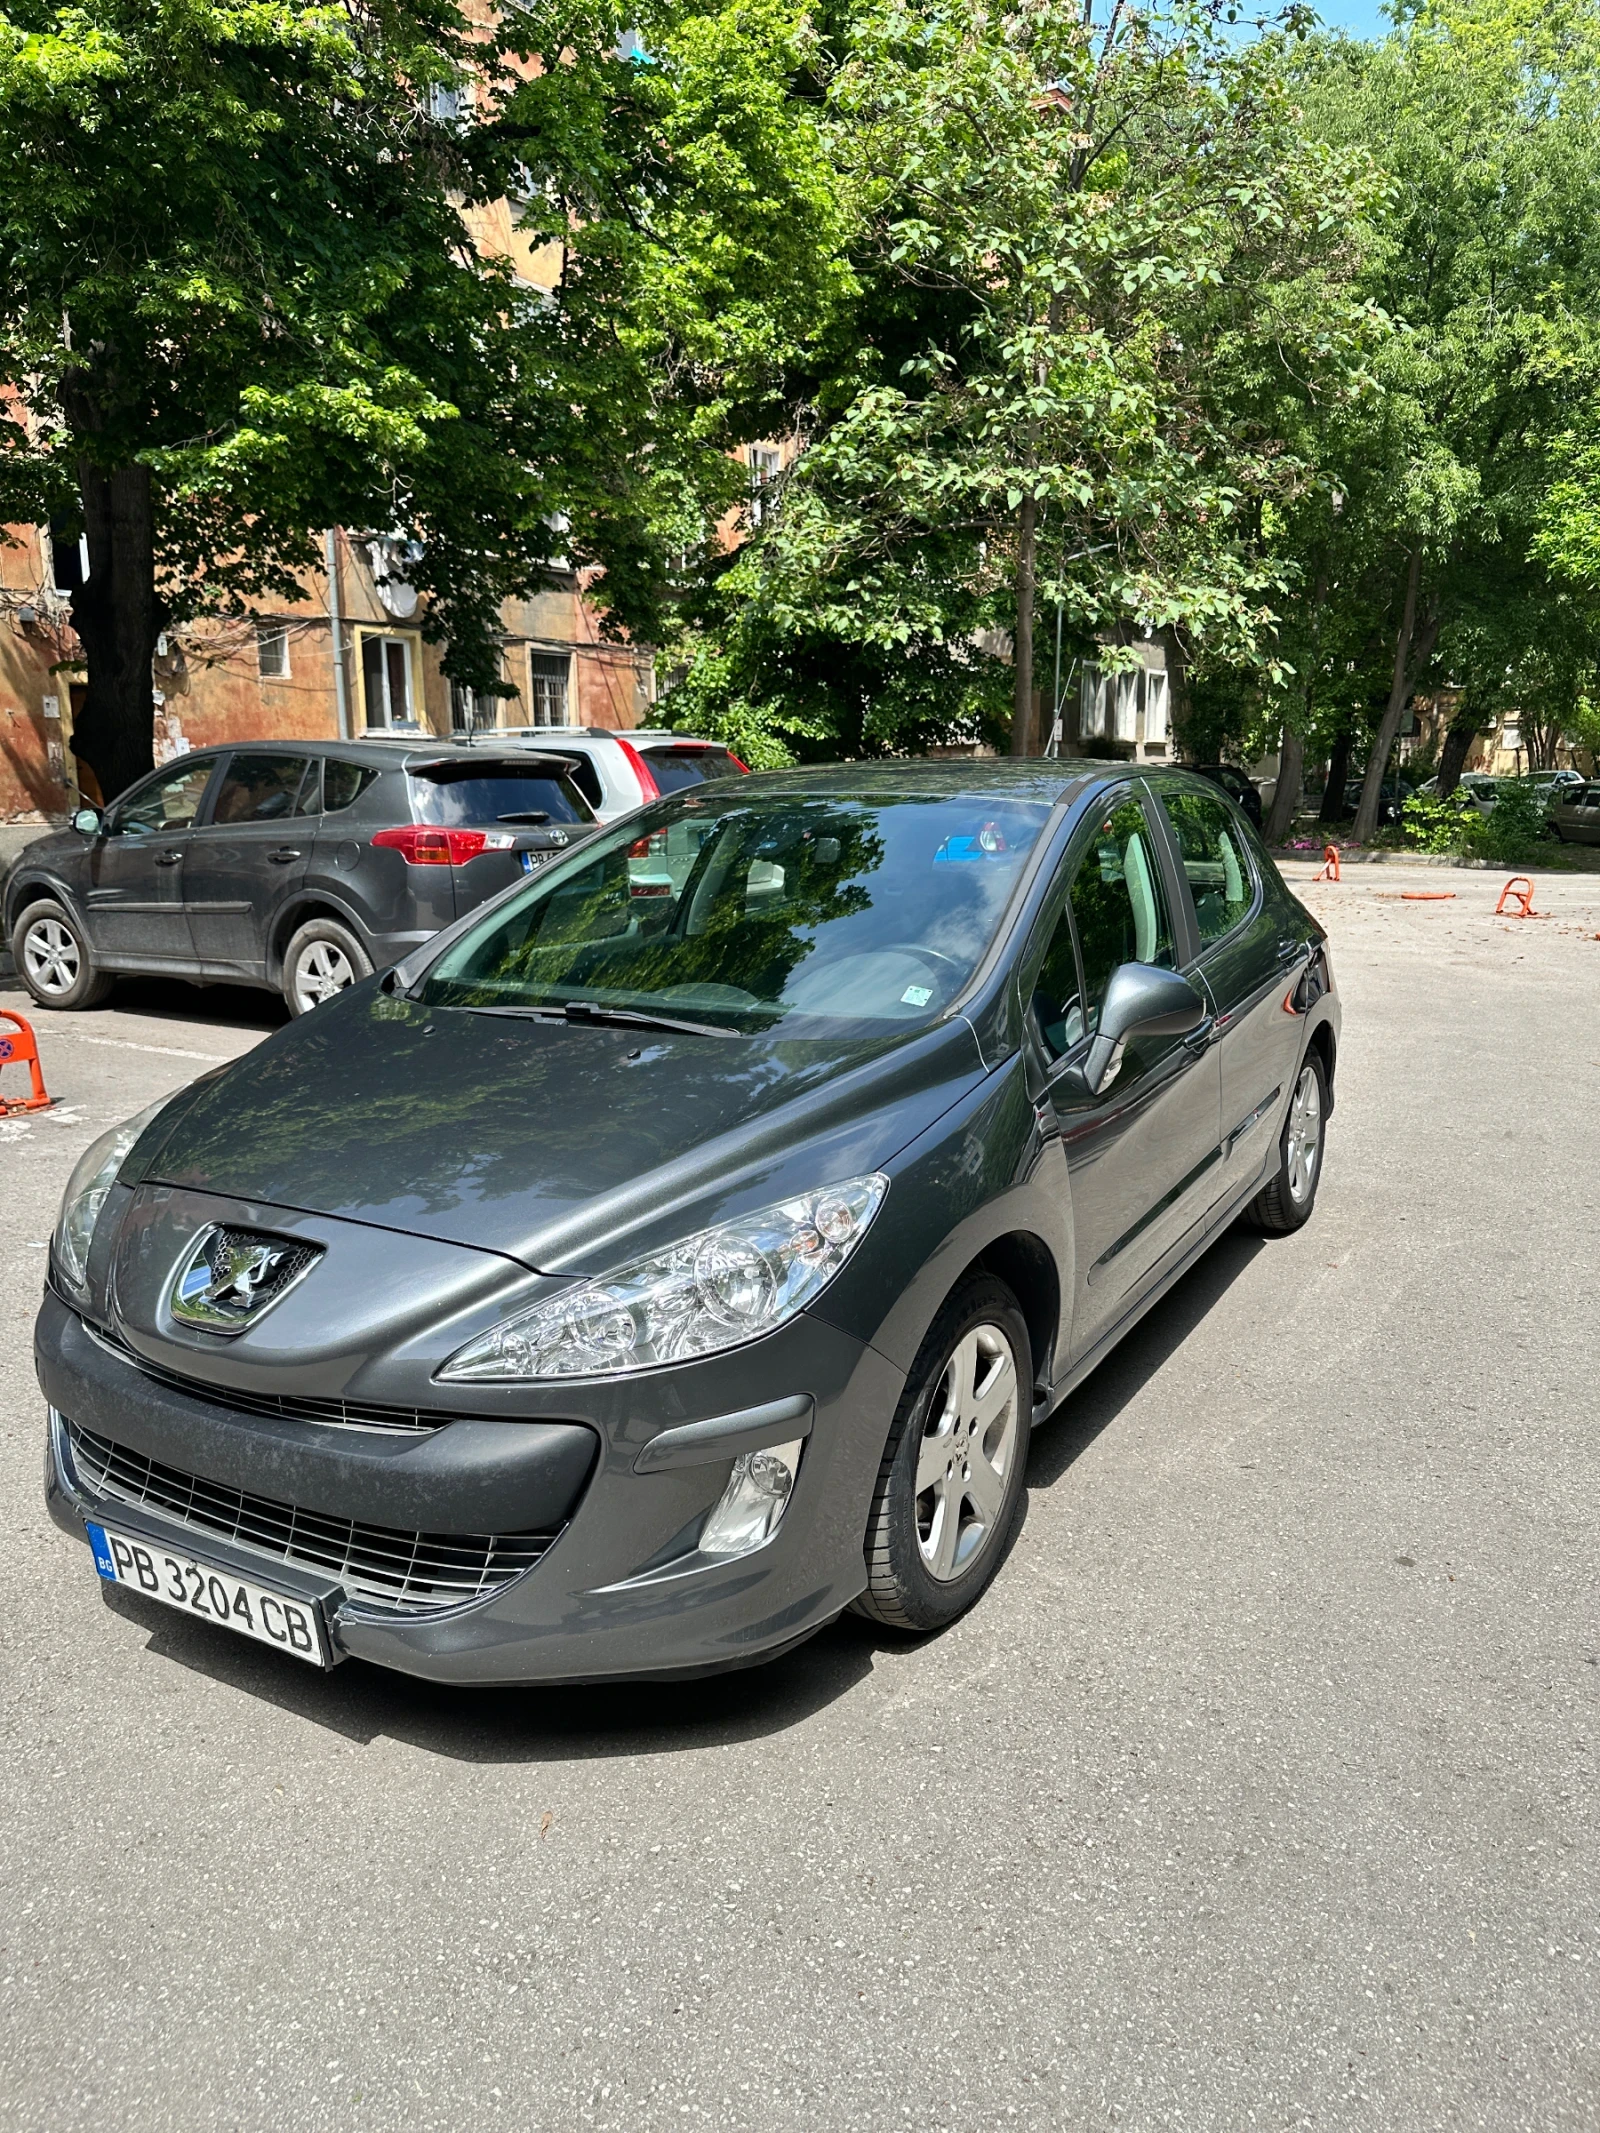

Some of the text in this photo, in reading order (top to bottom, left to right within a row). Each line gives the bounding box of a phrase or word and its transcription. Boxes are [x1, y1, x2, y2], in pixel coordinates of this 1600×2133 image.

[99, 1556, 113, 1573] BG
[109, 1536, 312, 1652] PB 3204 CB
